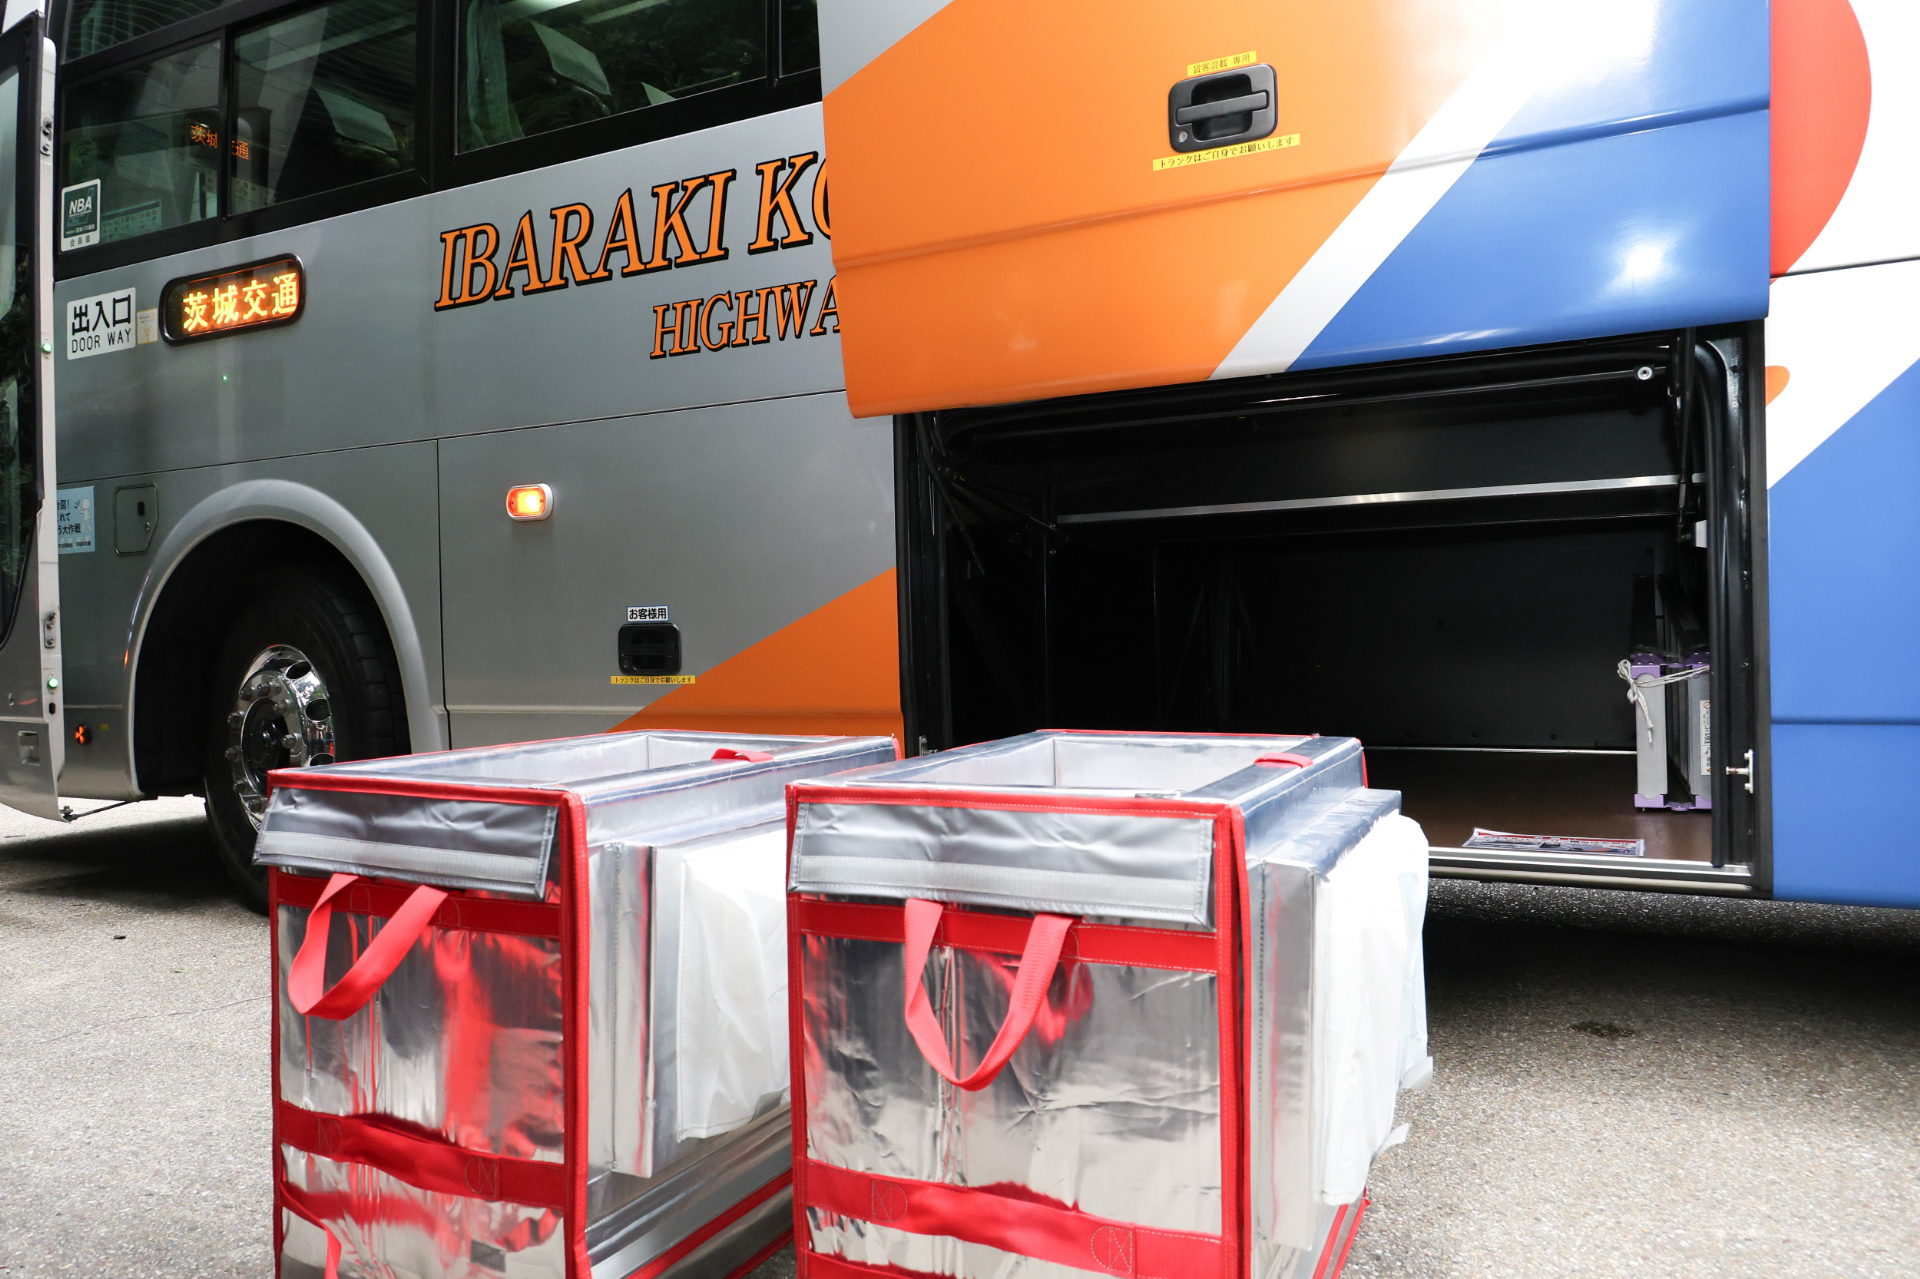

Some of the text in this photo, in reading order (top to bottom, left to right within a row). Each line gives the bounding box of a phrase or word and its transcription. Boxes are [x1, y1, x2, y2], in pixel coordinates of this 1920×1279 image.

[1193, 54, 1251, 74] 貨客混載 専用
[1160, 136, 1294, 169] トランクはご自身でお願いします
[69, 196, 92, 214] NBA
[434, 168, 737, 312] IBARAKI
[72, 294, 131, 336] 出入口
[182, 272, 299, 333] 茨城交通
[71, 328, 132, 354] DOOR WAY
[629, 607, 667, 620] お客様用
[615, 676, 692, 684] トランクはご自身でお願いします
